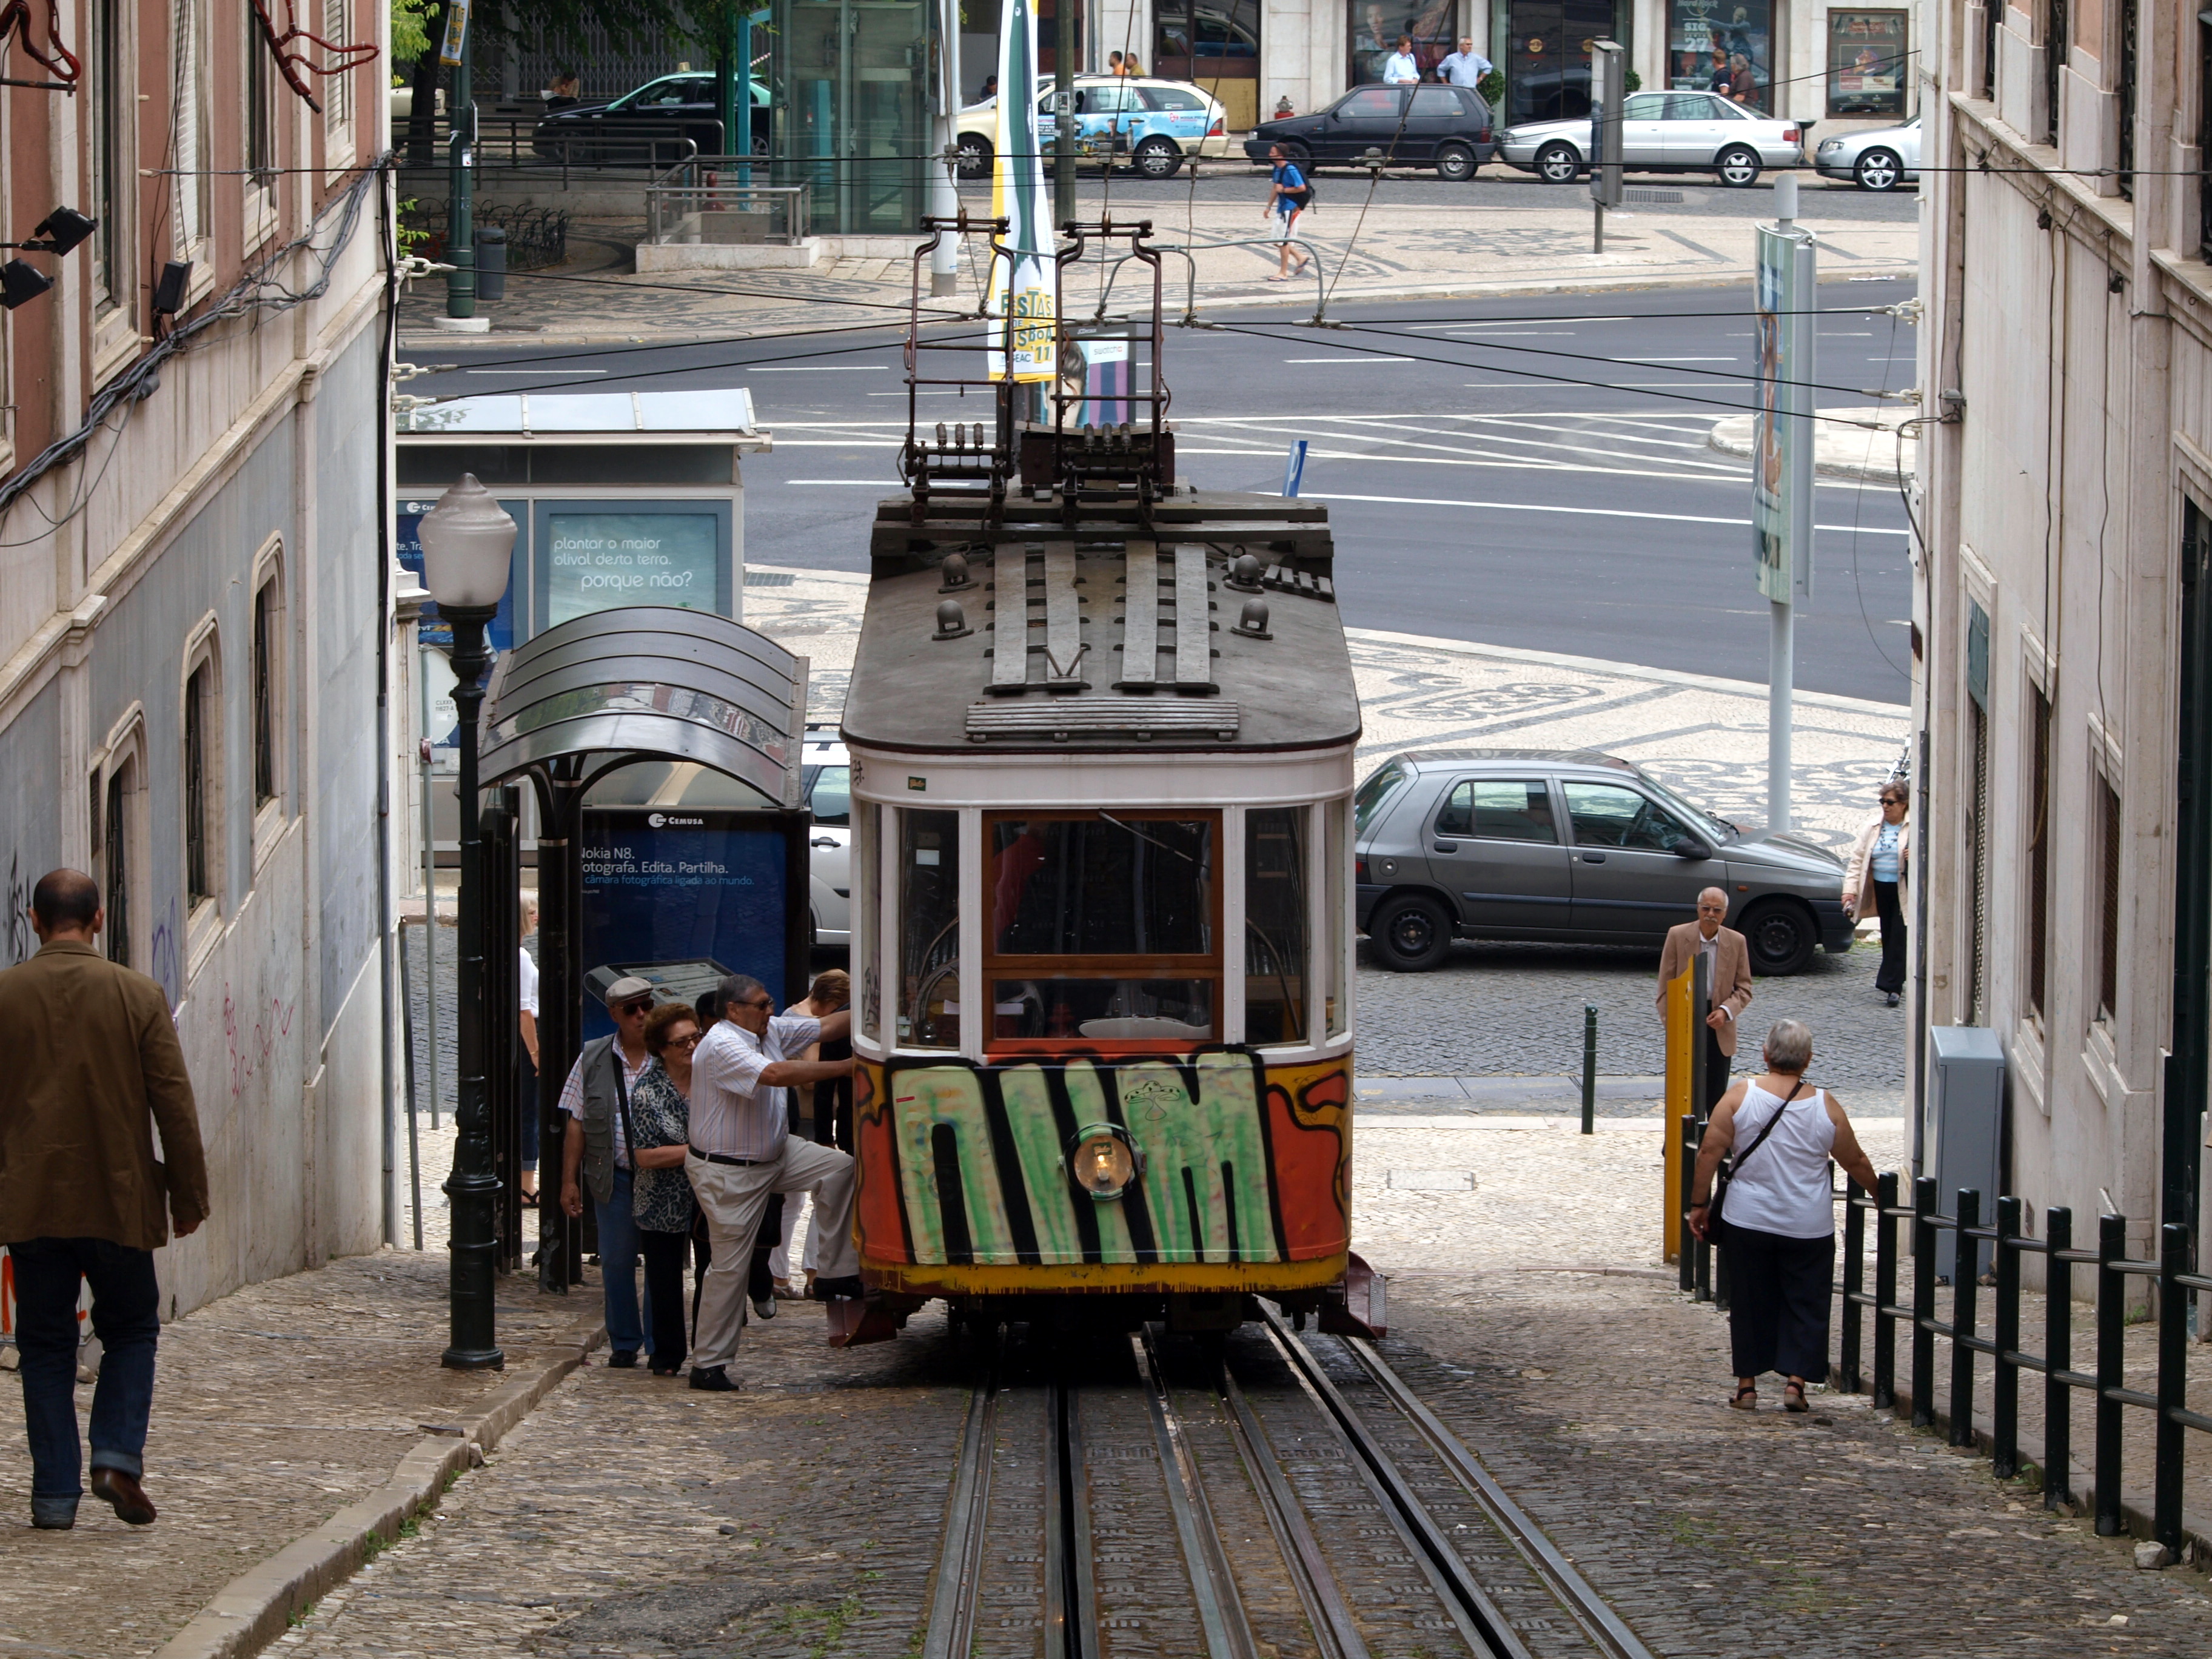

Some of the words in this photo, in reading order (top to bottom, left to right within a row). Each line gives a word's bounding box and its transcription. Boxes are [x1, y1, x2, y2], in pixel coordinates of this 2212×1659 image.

[1684, 38, 1709, 52] 27
[1001, 290, 1052, 318] FSTAS
[554, 537, 604, 552] plantar
[608, 539, 617, 549] o
[622, 537, 661, 549] maior
[554, 553, 591, 565] olival
[595, 552, 632, 565] desta
[637, 554, 672, 565] terra.
[581, 575, 644, 592] porque
[650, 571, 692, 587] não?
[614, 847, 635, 859] N8.
[582, 861, 638, 876] otografa.
[642, 861, 675, 873] Edita.
[679, 862, 729, 873] Partilha.
[585, 875, 619, 884] câmara
[622, 874, 673, 887] fotográfica
[675, 876, 703, 887] ligada
[719, 876, 755, 885] mundo.
